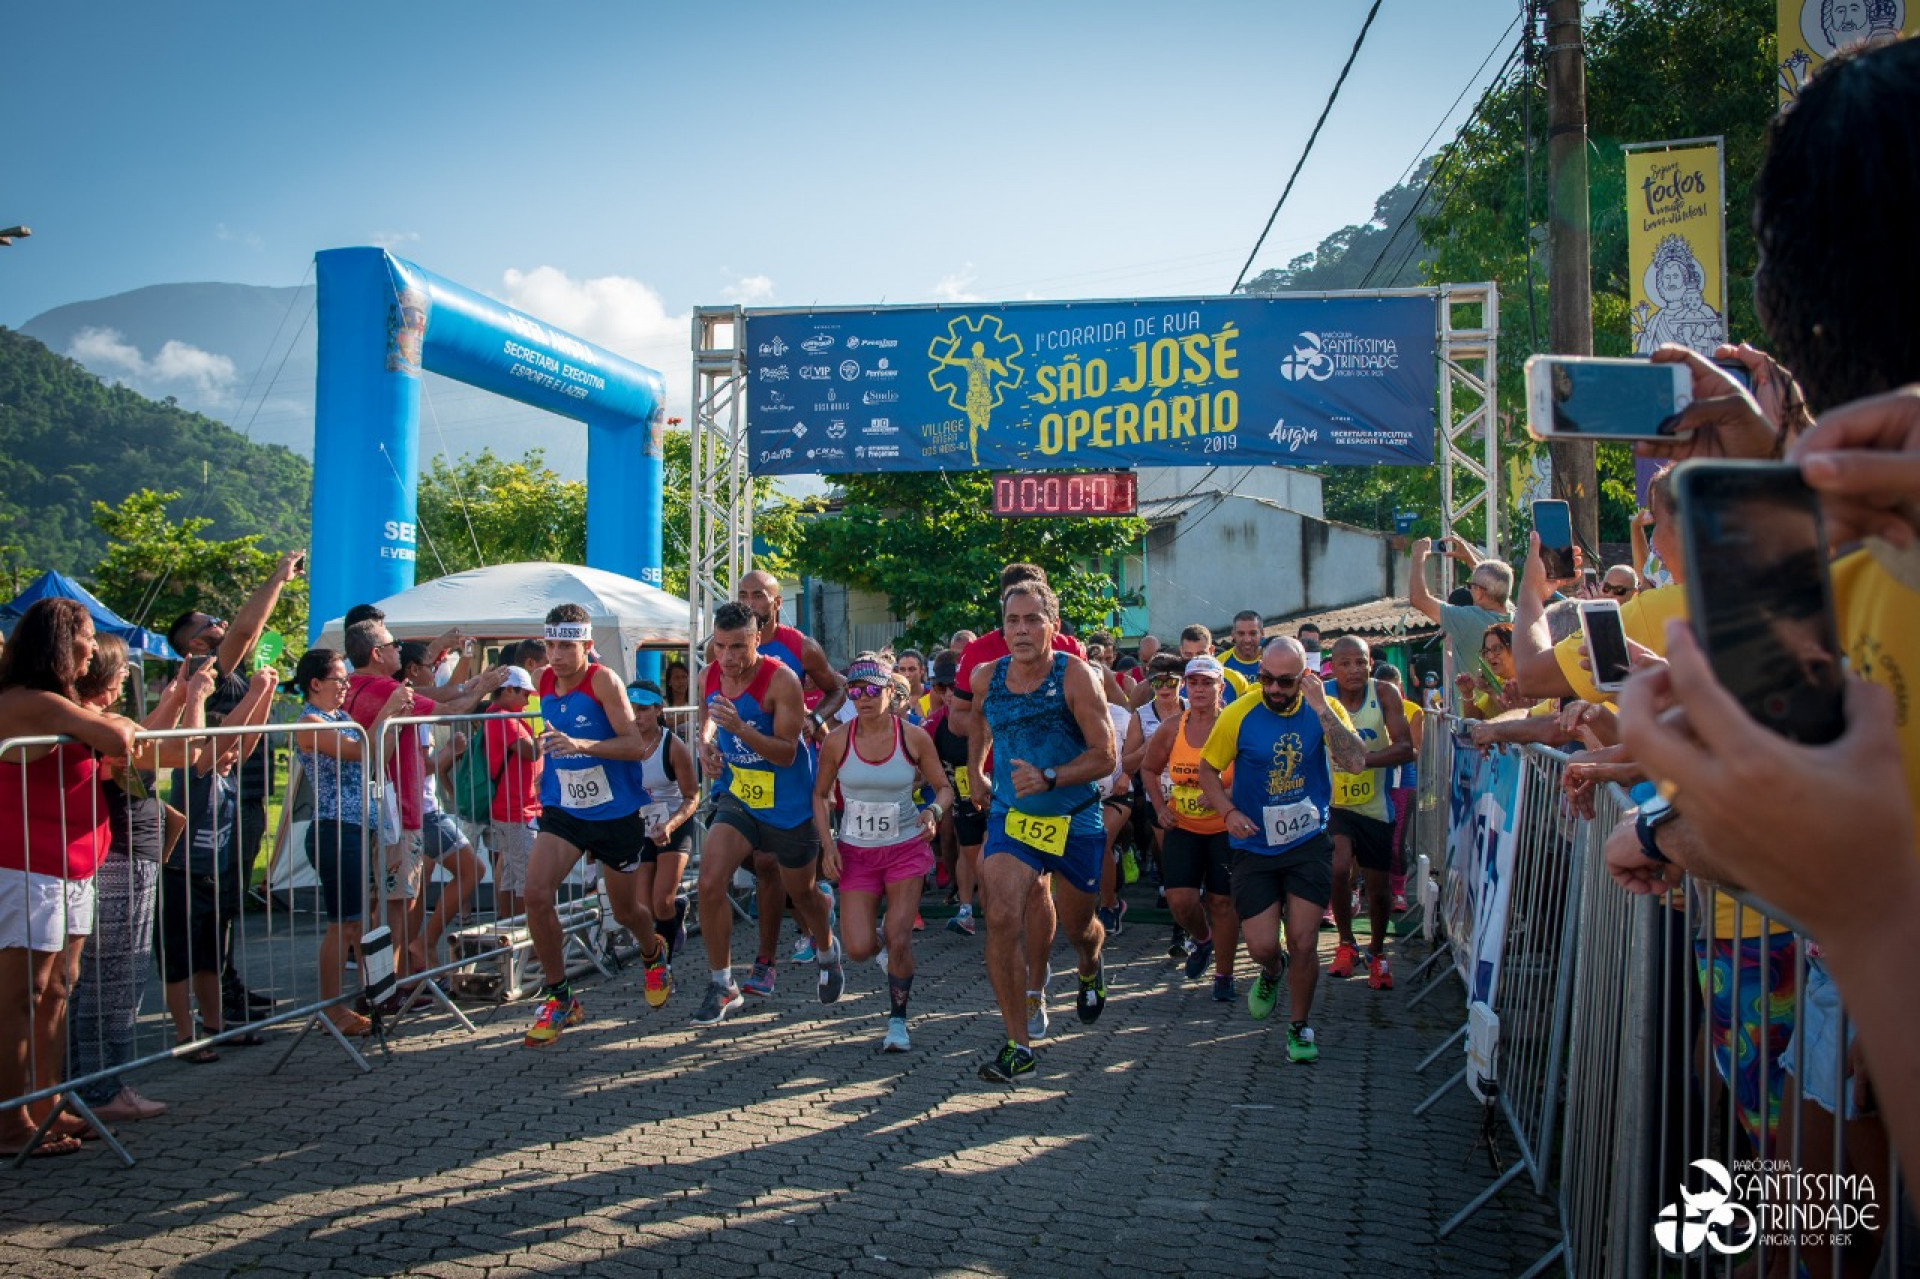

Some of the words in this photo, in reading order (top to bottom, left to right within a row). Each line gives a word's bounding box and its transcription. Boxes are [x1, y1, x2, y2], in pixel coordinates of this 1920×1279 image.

[1641, 169, 1705, 215] todos
[1048, 321, 1126, 350] CORRIDA
[1134, 316, 1156, 337] DE
[1163, 311, 1200, 334] RUA
[1320, 336, 1397, 353] SANTÍSSIMA
[503, 340, 559, 373] SECRETARIA
[561, 364, 605, 390] EXECUTIVA
[1033, 353, 1107, 405] SÃO
[1112, 321, 1239, 393] JOSÉ
[1333, 353, 1399, 370] TRINDADE
[509, 363, 553, 388] ESPORTE
[552, 379, 561, 391] E
[559, 382, 589, 400] LAZER
[922, 418, 964, 437] VILLAGE
[1034, 387, 1239, 455] OPERÁRIO
[1204, 434, 1237, 454] 2019
[1269, 417, 1318, 452] Angra
[567, 780, 600, 800] 089
[1340, 782, 1371, 798] 160
[855, 815, 890, 832] 115
[1017, 818, 1057, 844] 152
[1275, 813, 1311, 836] 042
